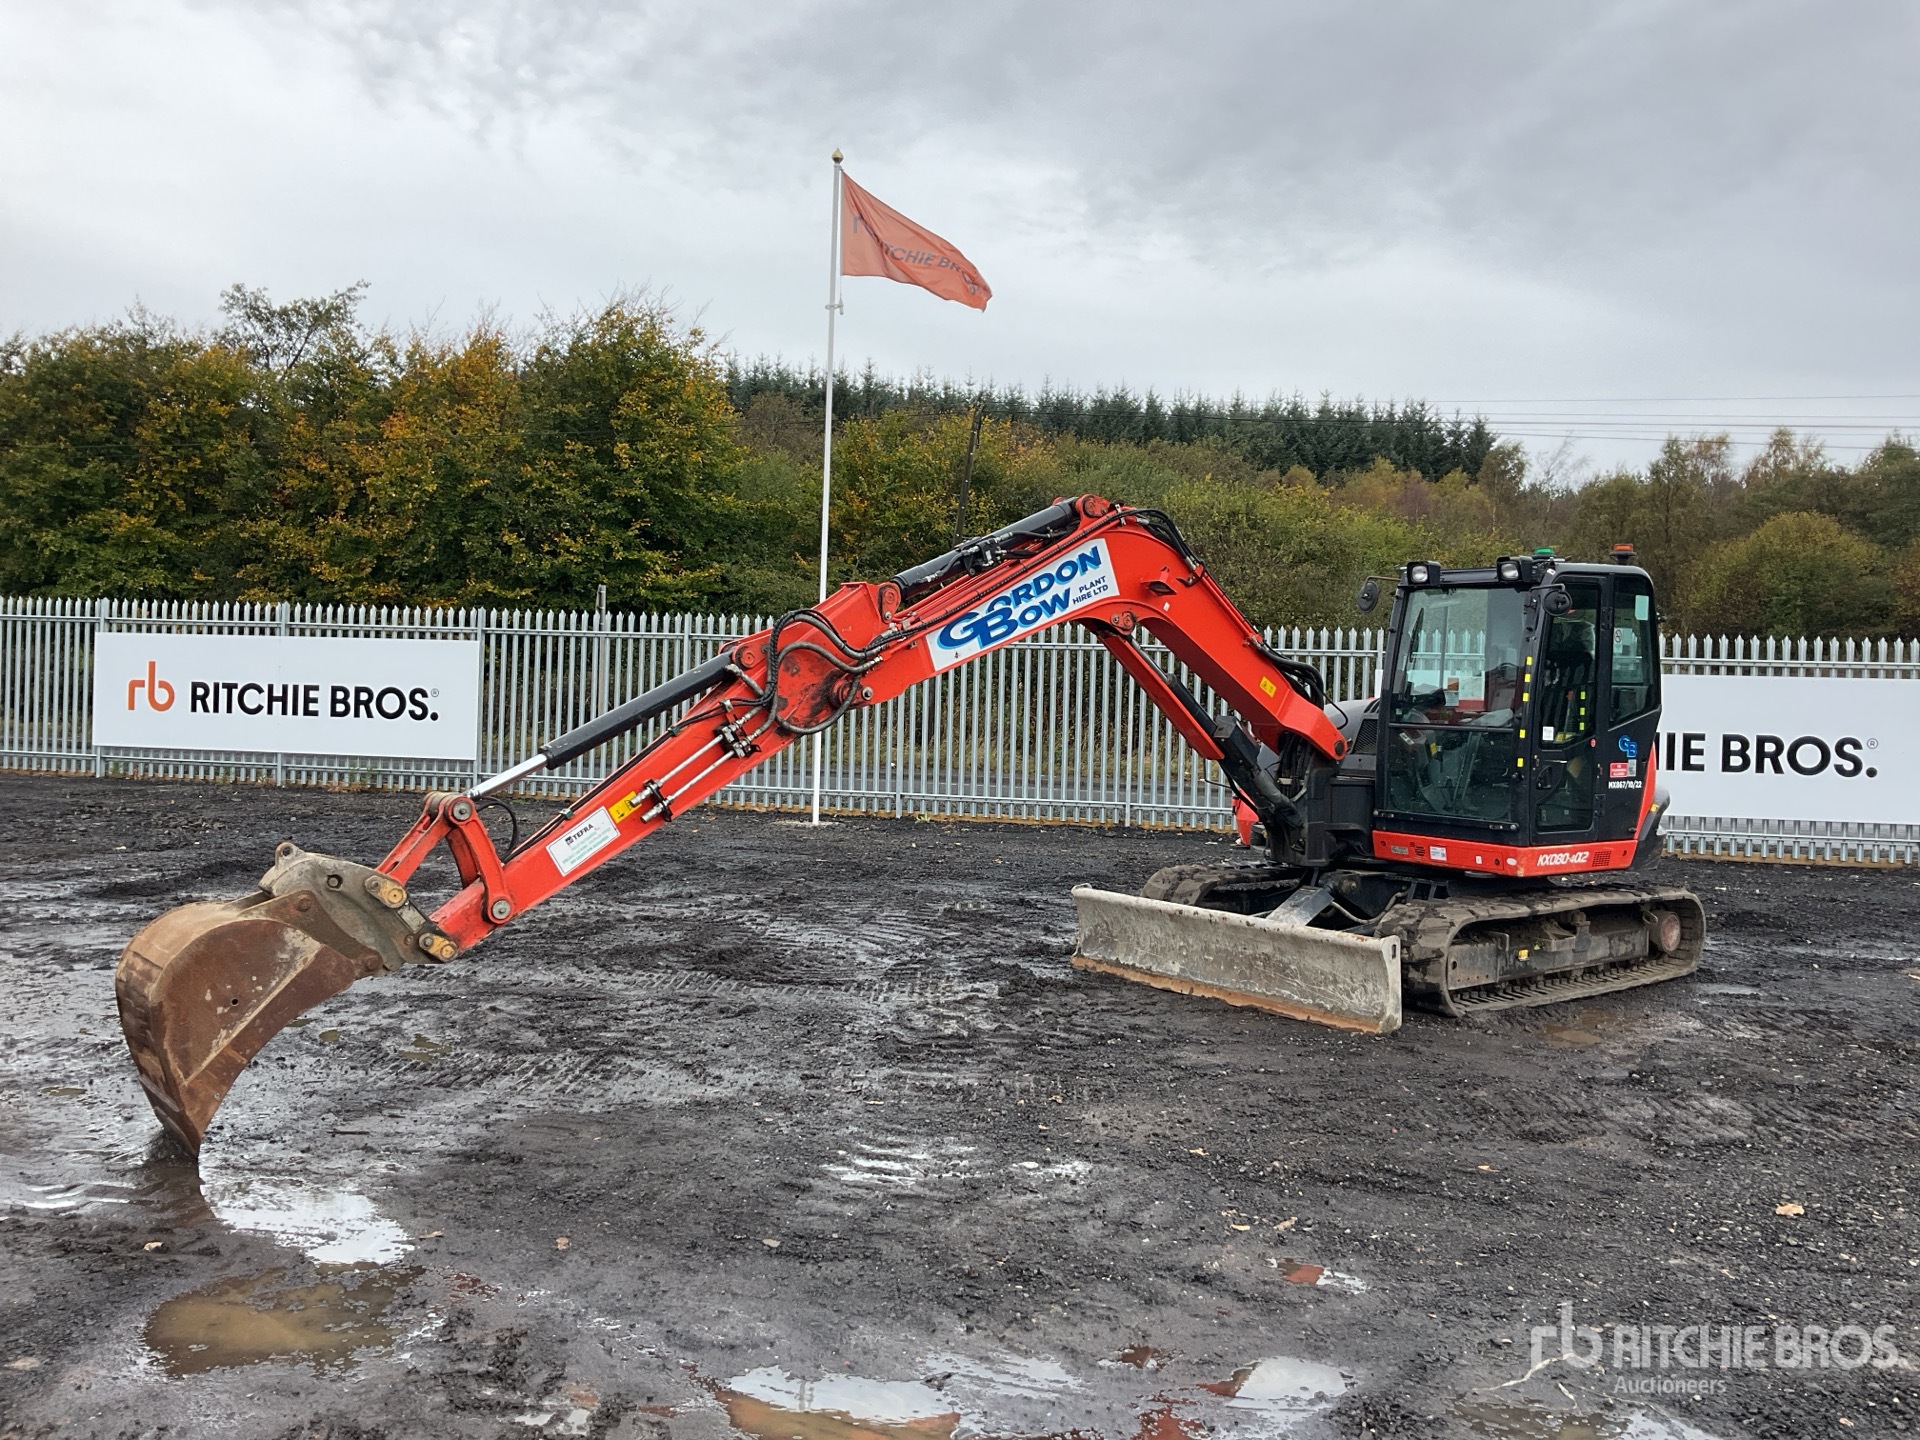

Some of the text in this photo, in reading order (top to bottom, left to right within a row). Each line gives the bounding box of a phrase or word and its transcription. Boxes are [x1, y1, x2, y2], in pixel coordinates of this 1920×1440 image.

[1079, 575, 1106, 593] PLANT
[1072, 584, 1109, 605] HIRE LTD
[127, 660, 176, 712] rb
[190, 681, 320, 717] RITCHIE
[573, 823, 594, 840] TEFRA
